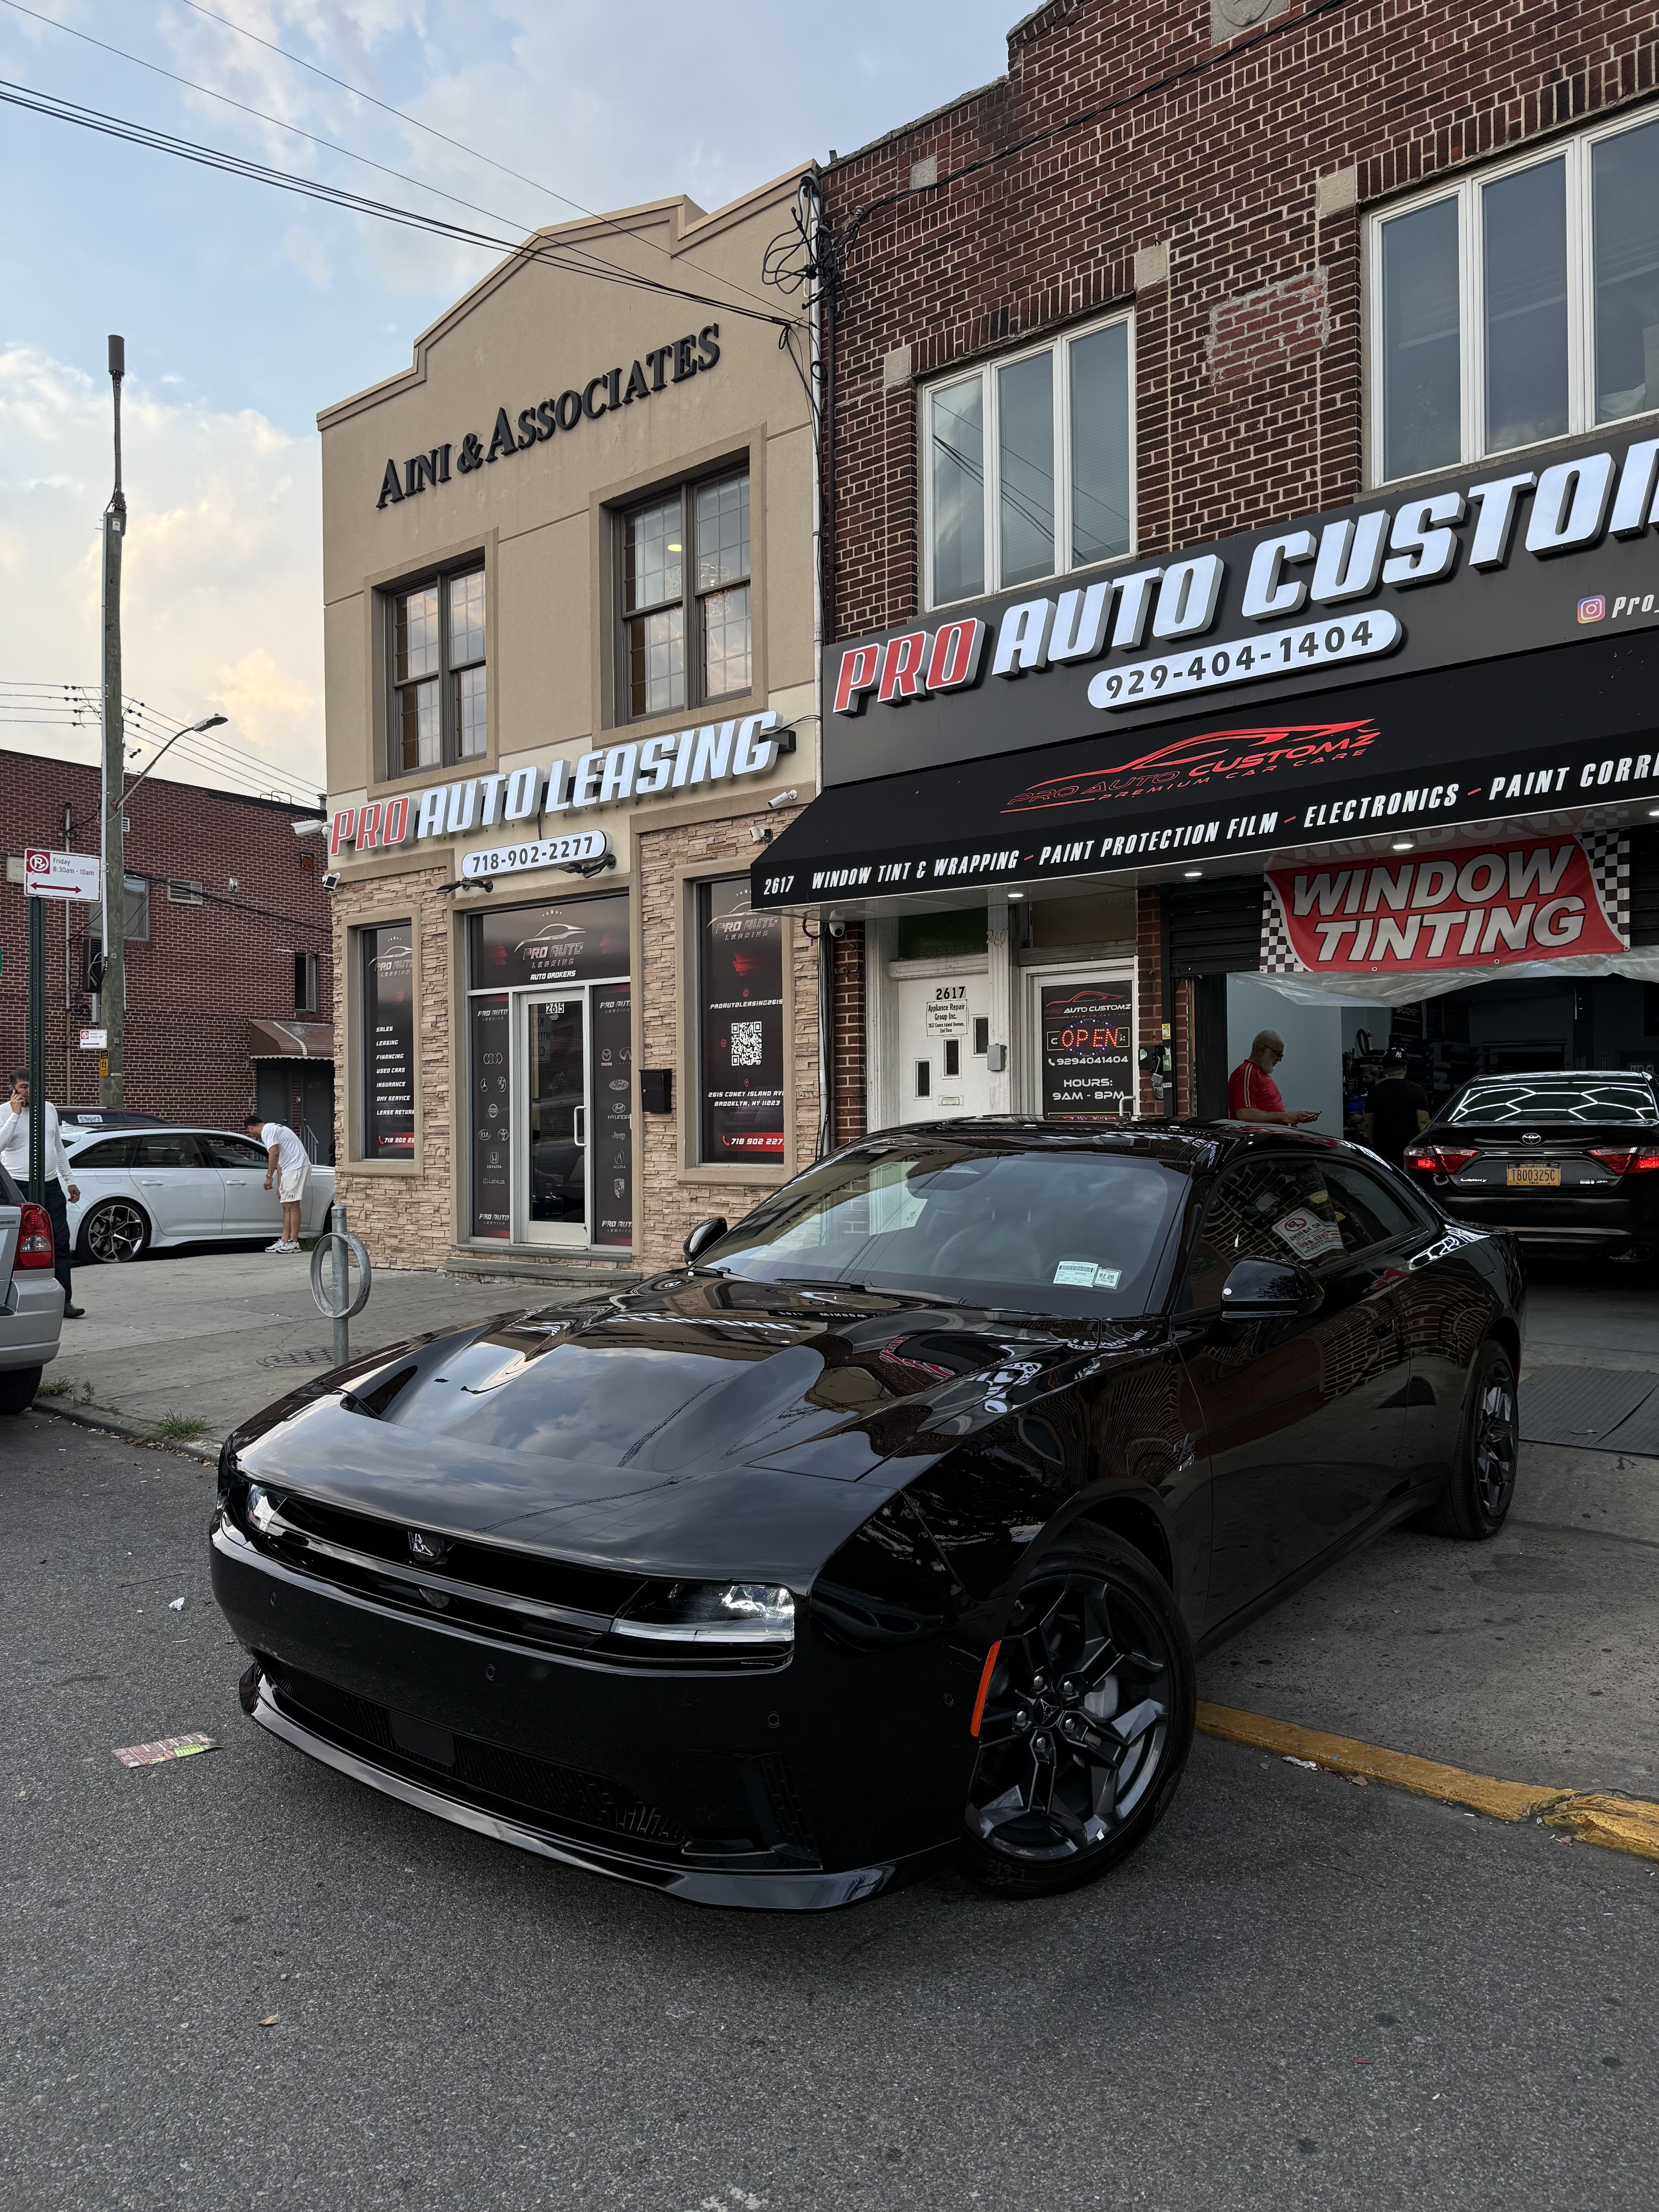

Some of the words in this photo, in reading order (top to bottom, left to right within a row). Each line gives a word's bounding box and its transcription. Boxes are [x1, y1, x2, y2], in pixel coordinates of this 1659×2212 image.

[375, 443, 452, 509] AINI
[456, 432, 484, 474] &
[484, 322, 720, 463] ASSOCIATES
[833, 617, 983, 715] PRO
[992, 554, 1222, 677] AUTO
[1106, 620, 1373, 700] 929-404-1404
[1007, 784, 1080, 806] PRO
[1081, 770, 1180, 795] AUTO
[1189, 730, 1381, 776] CUSTOMZ
[1098, 778, 1210, 800] PREMIUM
[1225, 766, 1275, 779] CAR
[1293, 749, 1366, 768] CARE
[331, 796, 413, 856] PRO
[417, 766, 541, 839] AUTO
[545, 711, 781, 814] LEASING
[763, 875, 794, 896] 2617
[811, 868, 869, 890] WINDOW
[877, 862, 911, 883] TINT
[915, 861, 927, 879] &
[934, 849, 1020, 877] WRAPPING
[1039, 840, 1095, 866] PAINT
[1100, 821, 1220, 858] PROTECTION
[1226, 811, 1279, 840] FILM
[1304, 783, 1460, 829] ELECTRONICS
[1489, 766, 1570, 801] PAINT
[53, 858, 70, 866] Friday
[473, 836, 594, 873] 718-902-2277
[1293, 844, 1576, 917] WINDOW
[716, 921, 742, 934] PRO
[743, 916, 779, 931] AUTO
[1315, 895, 1586, 963] TINTING
[523, 946, 548, 960] PRO
[550, 942, 584, 957] AUTO
[374, 962, 392, 972] PRO
[532, 958, 574, 969] LEASING
[547, 970, 576, 979] BROKERS
[936, 986, 965, 1000] 2617
[546, 1003, 563, 1013] 2615
[928, 1004, 948, 1013] Appliance
[950, 1003, 965, 1011] Repair
[1089, 1004, 1132, 1012] CUSTOMZ
[1062, 1028, 1118, 1047] OPEN
[1056, 1055, 1128, 1065] 9294041404
[1064, 1078, 1113, 1087] HOURS:
[1052, 1091, 1083, 1100] 9AM
[1094, 1090, 1124, 1100] 8PM
[1511, 1169, 1555, 1182] T800325C
